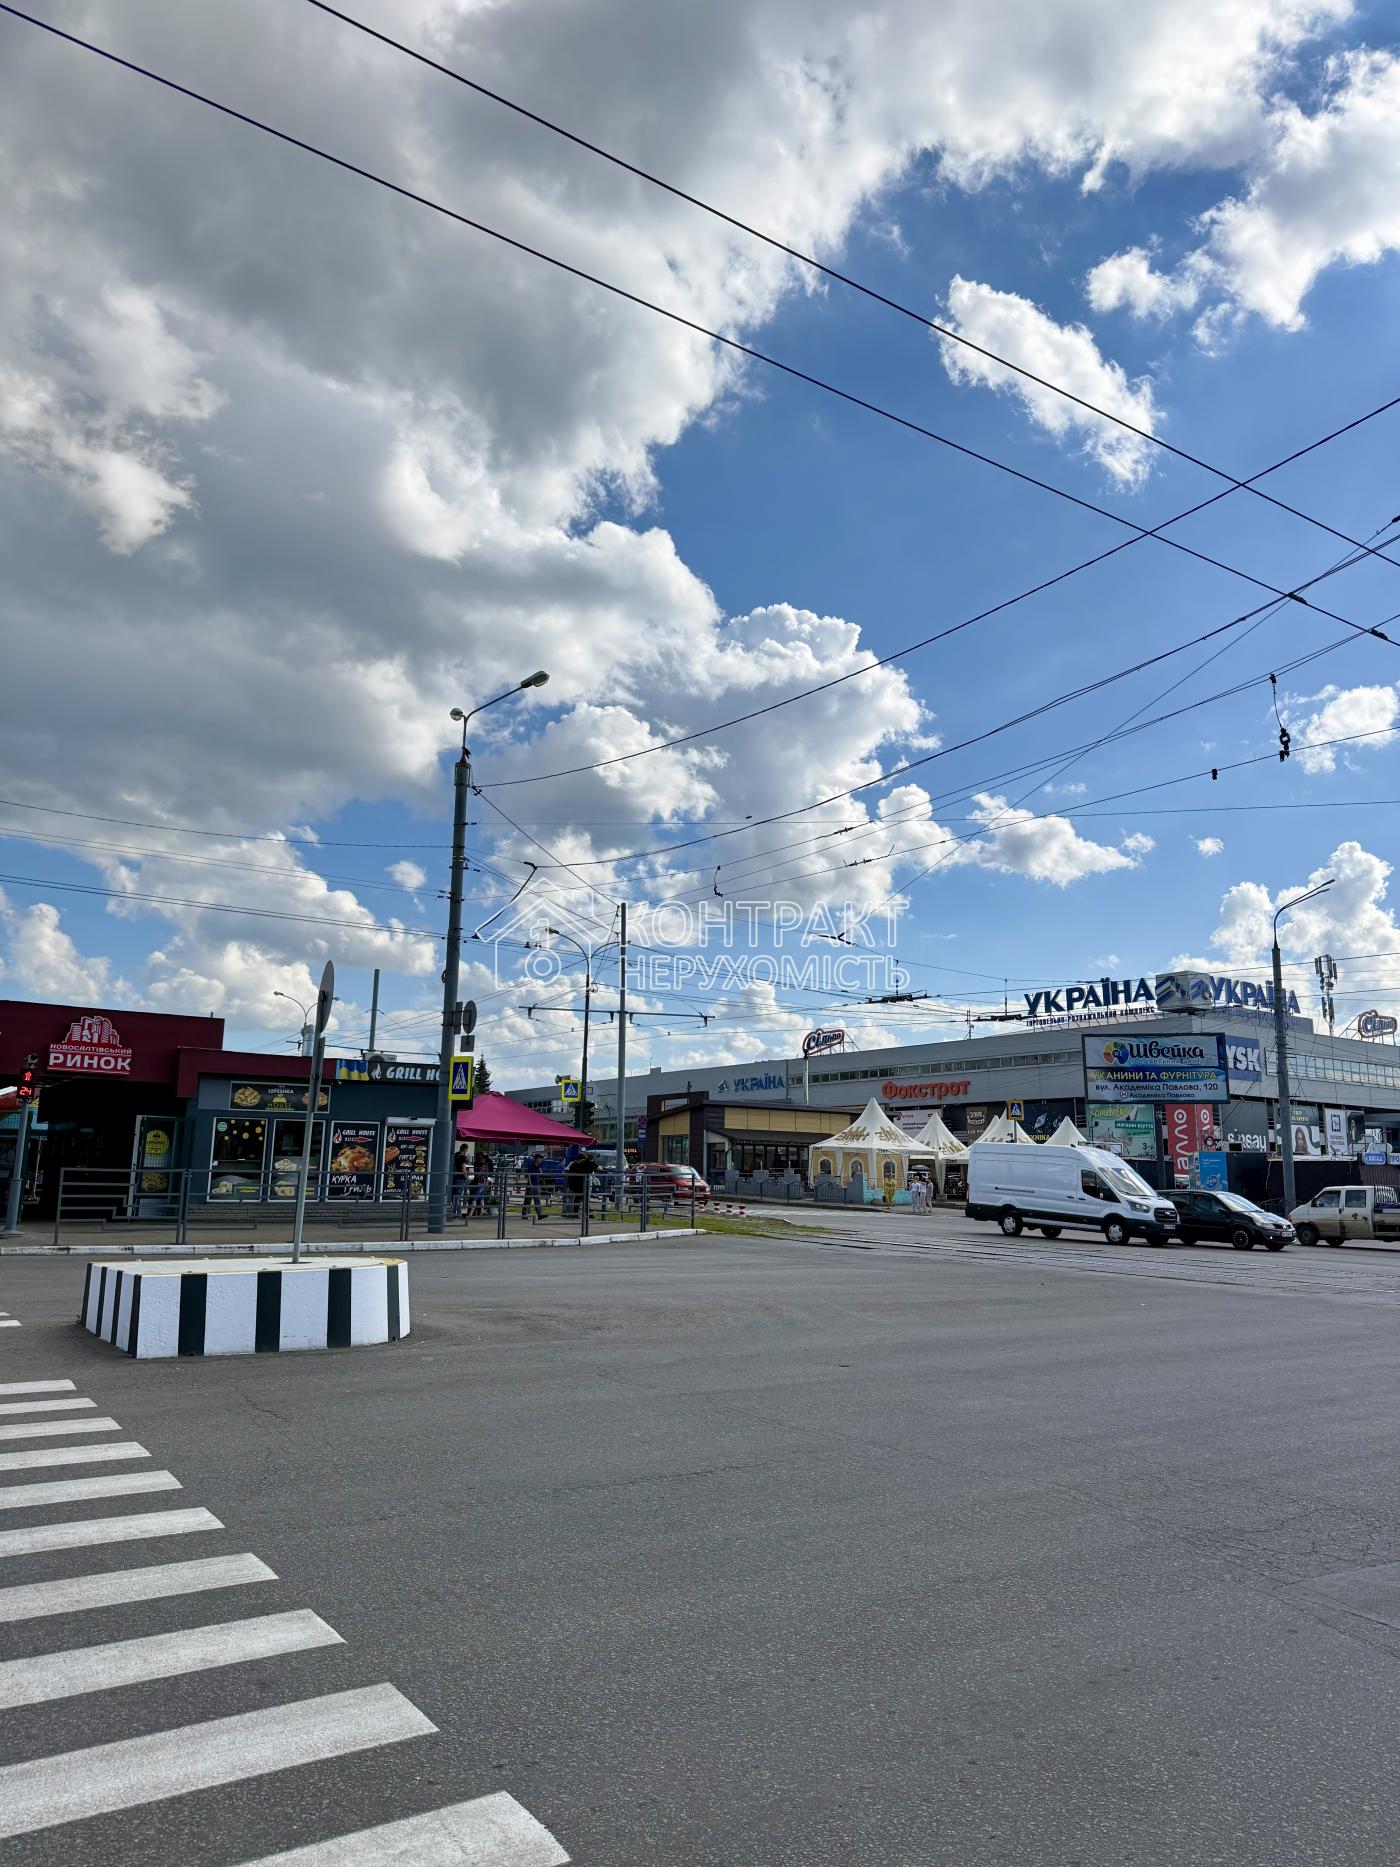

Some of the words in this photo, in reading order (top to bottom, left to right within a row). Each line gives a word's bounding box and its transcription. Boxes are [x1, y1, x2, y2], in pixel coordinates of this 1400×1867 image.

[1024, 977, 1156, 1015] УКРАЇНА
[50, 1043, 132, 1055] НОВОСАЛТІВСЬКИЙ
[806, 1031, 842, 1050] Сільпо
[1127, 1041, 1205, 1059] Швейка
[1226, 1045, 1261, 1071] YSK
[49, 1052, 131, 1071] РИНОК
[386, 1066, 421, 1080] GRILL
[1145, 1071, 1158, 1080] ТА
[1160, 1071, 1217, 1080] ФУРНІТУРА
[20, 1086, 32, 1096] 24
[734, 1073, 785, 1092] УКРАЇНА
[882, 1081, 970, 1100] Фокстрот
[1114, 1083, 1160, 1091] Академіка
[1162, 1083, 1202, 1092] Павлова,
[1204, 1083, 1218, 1091] 120
